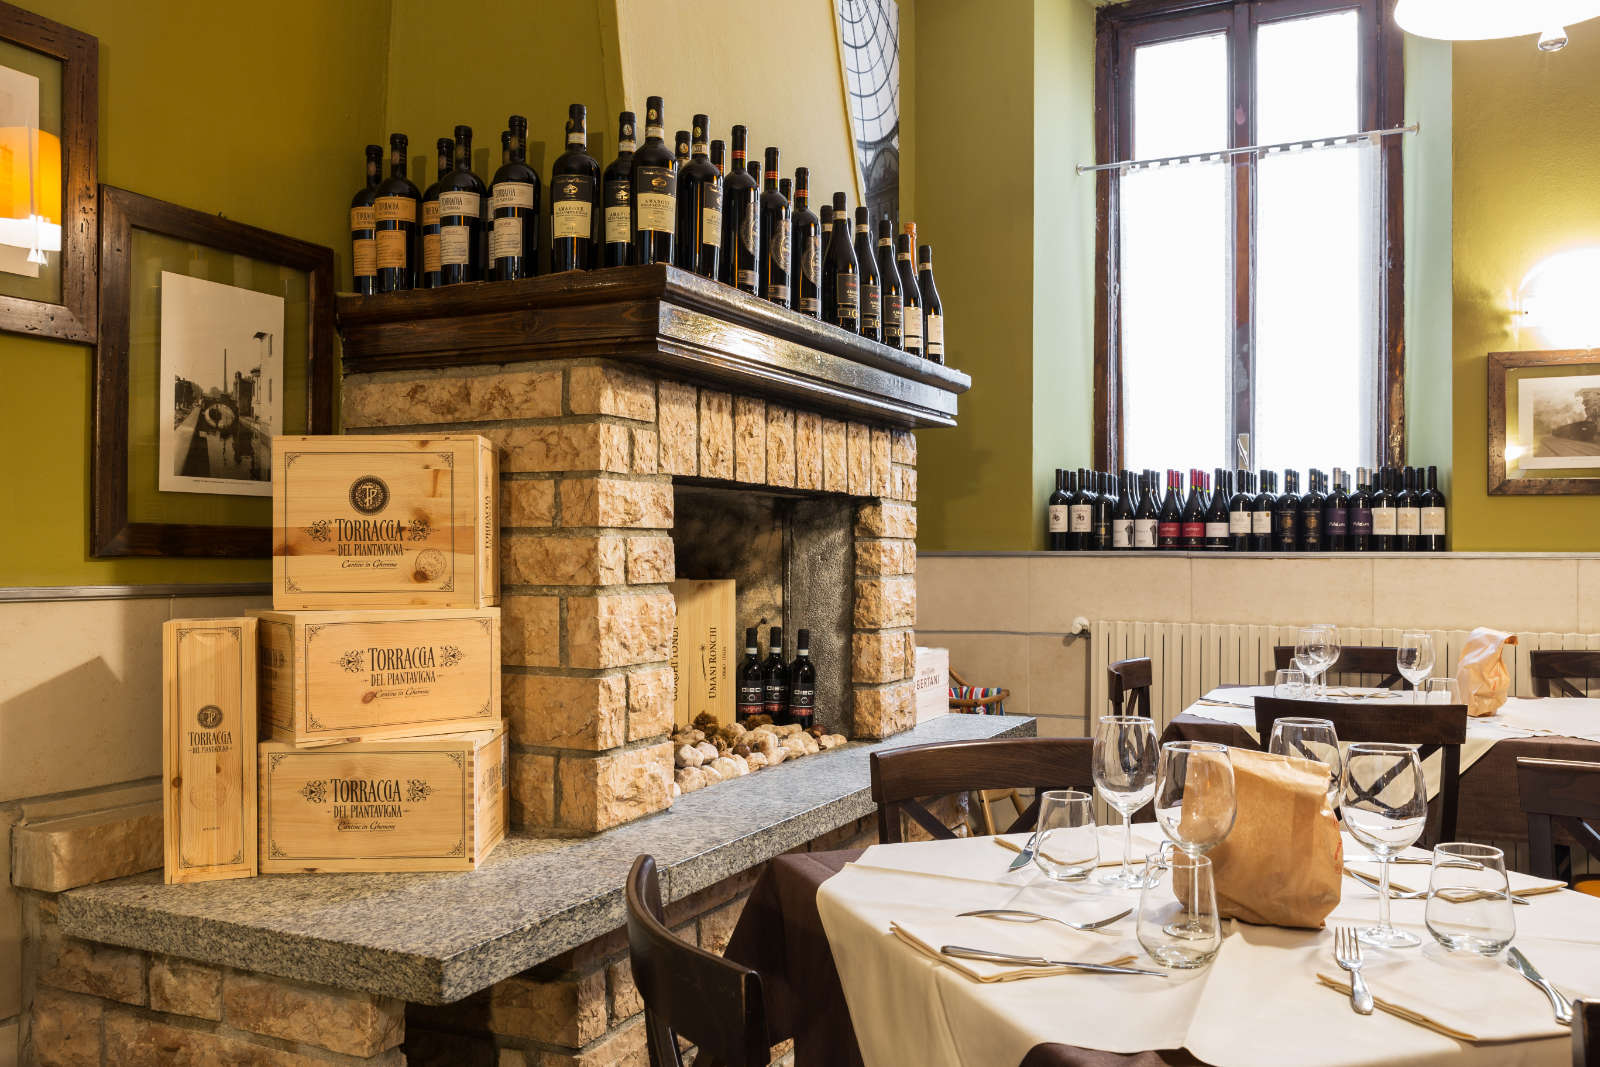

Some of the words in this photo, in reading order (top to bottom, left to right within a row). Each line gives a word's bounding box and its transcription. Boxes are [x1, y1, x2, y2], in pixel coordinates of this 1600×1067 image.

[338, 544, 352, 556] DEL
[354, 543, 404, 556] PIANTAVIGNA
[709, 627, 717, 665] RONCHI
[371, 673, 384, 686] DEL
[387, 671, 436, 685] PIANTAVIGNA
[709, 666, 717, 699] UMANI
[917, 674, 940, 690] BERTANI
[334, 805, 349, 818] DEL
[350, 804, 402, 818] PIANTAVIGNA
